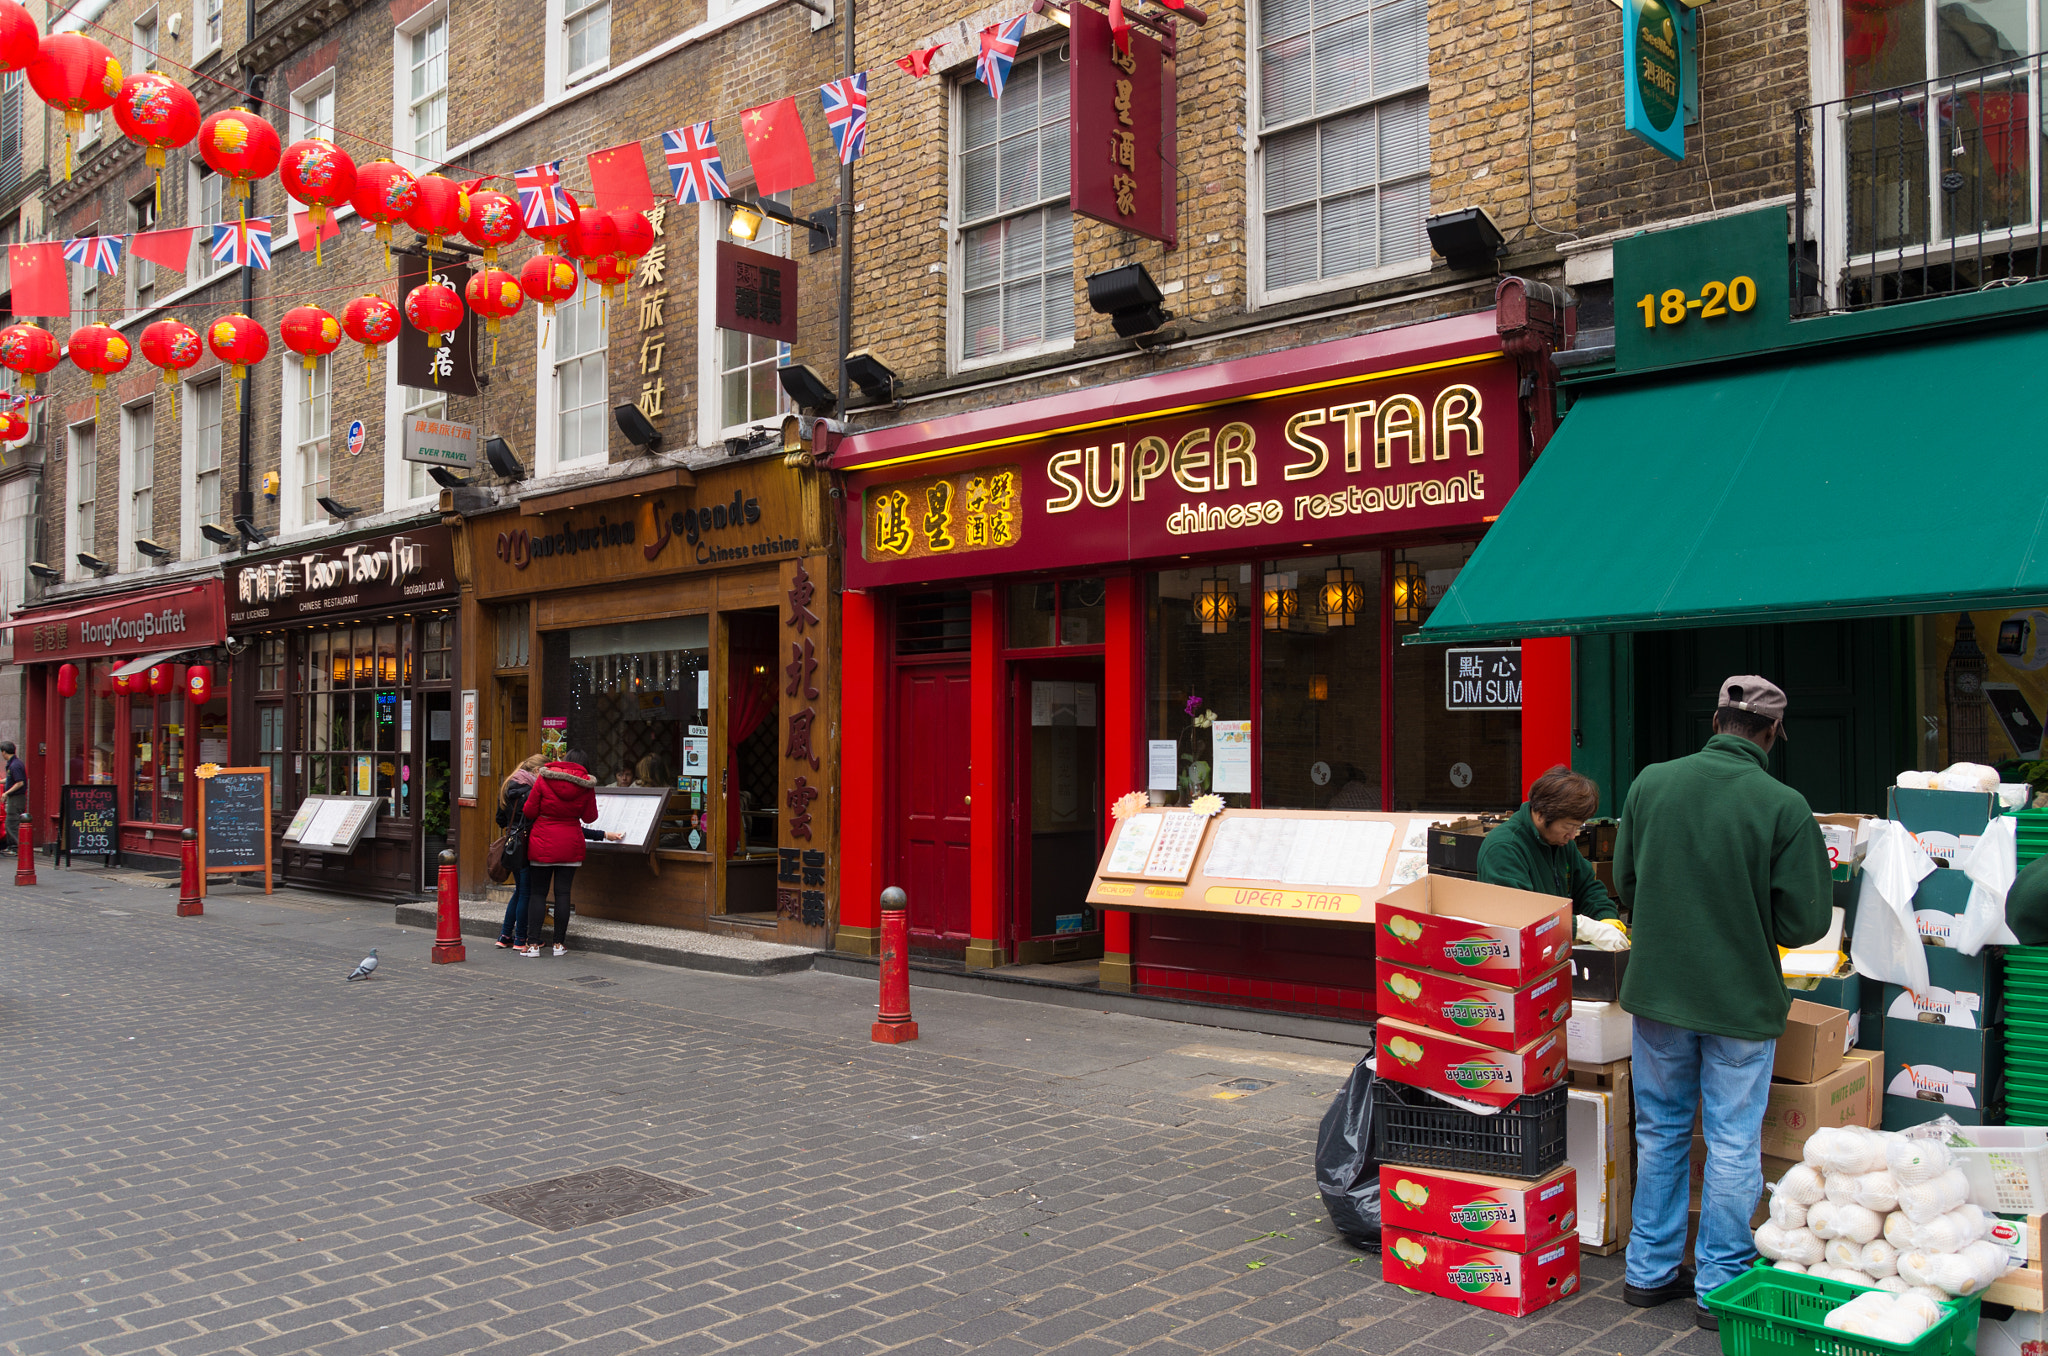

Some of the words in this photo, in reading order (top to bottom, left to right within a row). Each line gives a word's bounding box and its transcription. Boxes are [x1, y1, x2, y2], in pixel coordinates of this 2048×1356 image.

[1637, 275, 1758, 329] 18-20
[418, 446, 439, 457] EVER
[441, 448, 468, 462] TRAVEL
[1046, 421, 1258, 514] SUPER
[1284, 383, 1484, 481] STAR
[1166, 499, 1284, 535] chinese
[1294, 469, 1485, 521] restaurant
[496, 516, 636, 570] Manchurian
[643, 490, 761, 561] Legends
[696, 541, 749, 565] Chinese
[752, 534, 799, 556] cuisine
[301, 553, 344, 592] Tao
[343, 544, 389, 585] Tao
[390, 536, 423, 587] Ju
[403, 579, 445, 596] taotaoju.co.uk
[299, 599, 322, 612] CHINESE
[323, 594, 359, 609] RESTAURANT
[231, 612, 246, 621] FULLY
[246, 608, 270, 620] LICENSED
[80, 608, 187, 647] HongKongBuffet
[1458, 654, 1517, 679] 點心
[1452, 680, 1482, 703] DIM
[1485, 679, 1522, 703] SUM
[691, 727, 707, 735] OPEN
[464, 702, 475, 785] 康泰旅行社
[1443, 946, 1472, 958] PEAR
[1473, 944, 1511, 958] FRESH
[1442, 1007, 1468, 1018] PEAR
[1471, 1007, 1505, 1021] FRESH
[1445, 1069, 1473, 1081] PEAR
[1476, 1069, 1512, 1083] FRESH
[1831, 1085, 1848, 1106] WHITE
[1849, 1075, 1866, 1096] GOURD
[1450, 1211, 1478, 1223] PEAR
[1479, 1209, 1517, 1223] FRESH
[1447, 1272, 1474, 1284] PEAR
[1476, 1271, 1511, 1286] FRESH
